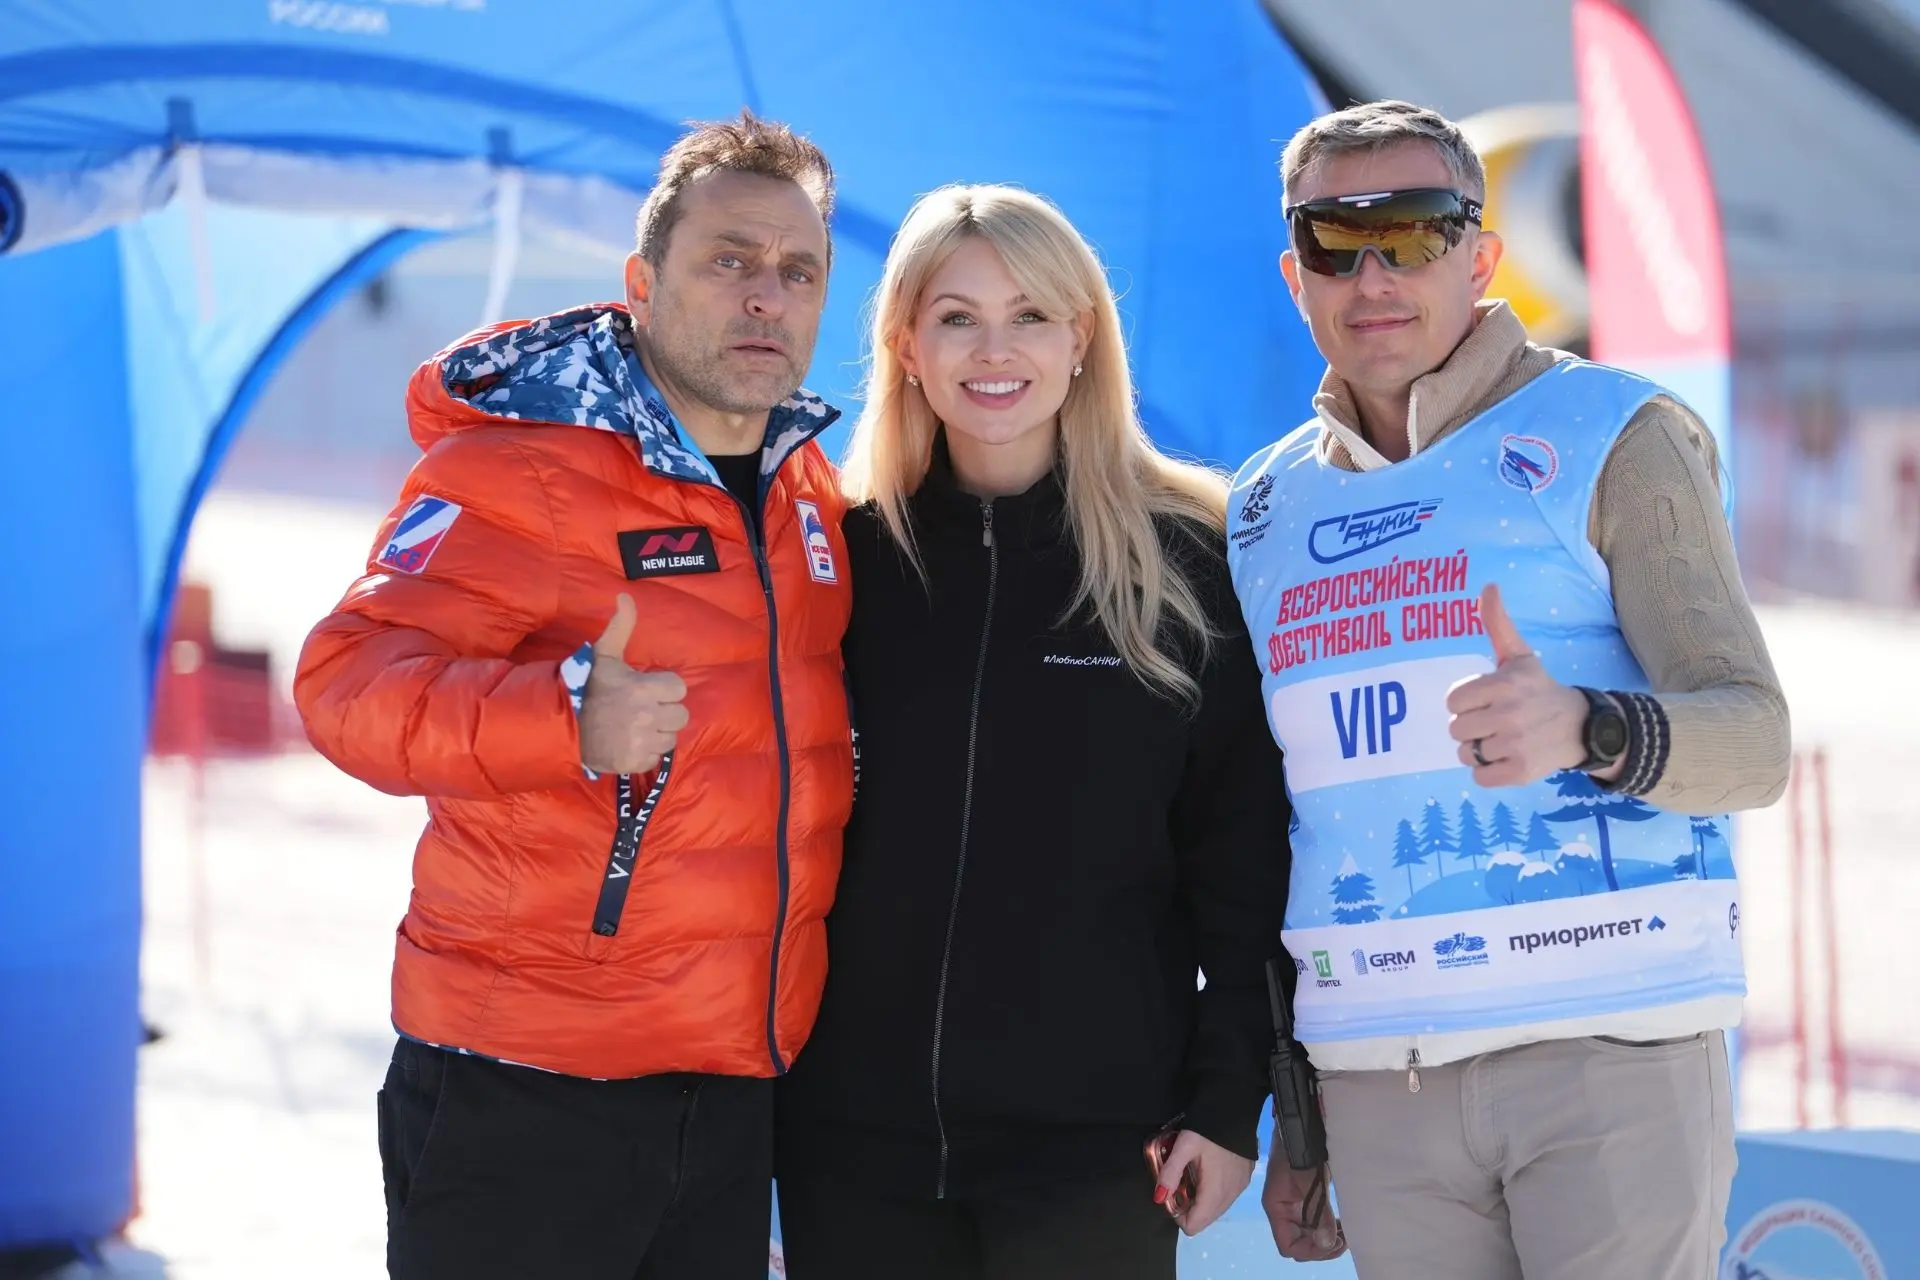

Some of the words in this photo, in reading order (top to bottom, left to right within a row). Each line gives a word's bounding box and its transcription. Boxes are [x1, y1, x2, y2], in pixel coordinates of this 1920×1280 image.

[642, 557, 667, 570] NEW
[668, 555, 705, 568] LEAGUE
[1276, 548, 1469, 627] ВСЕРОССИЙСКИЙ
[1268, 610, 1392, 676] ФЕСТИВАЛЬ
[1401, 598, 1483, 642] САНОК
[1330, 680, 1407, 760] VIP
[1369, 950, 1416, 967] GRM
[1509, 917, 1643, 954] приоритет
